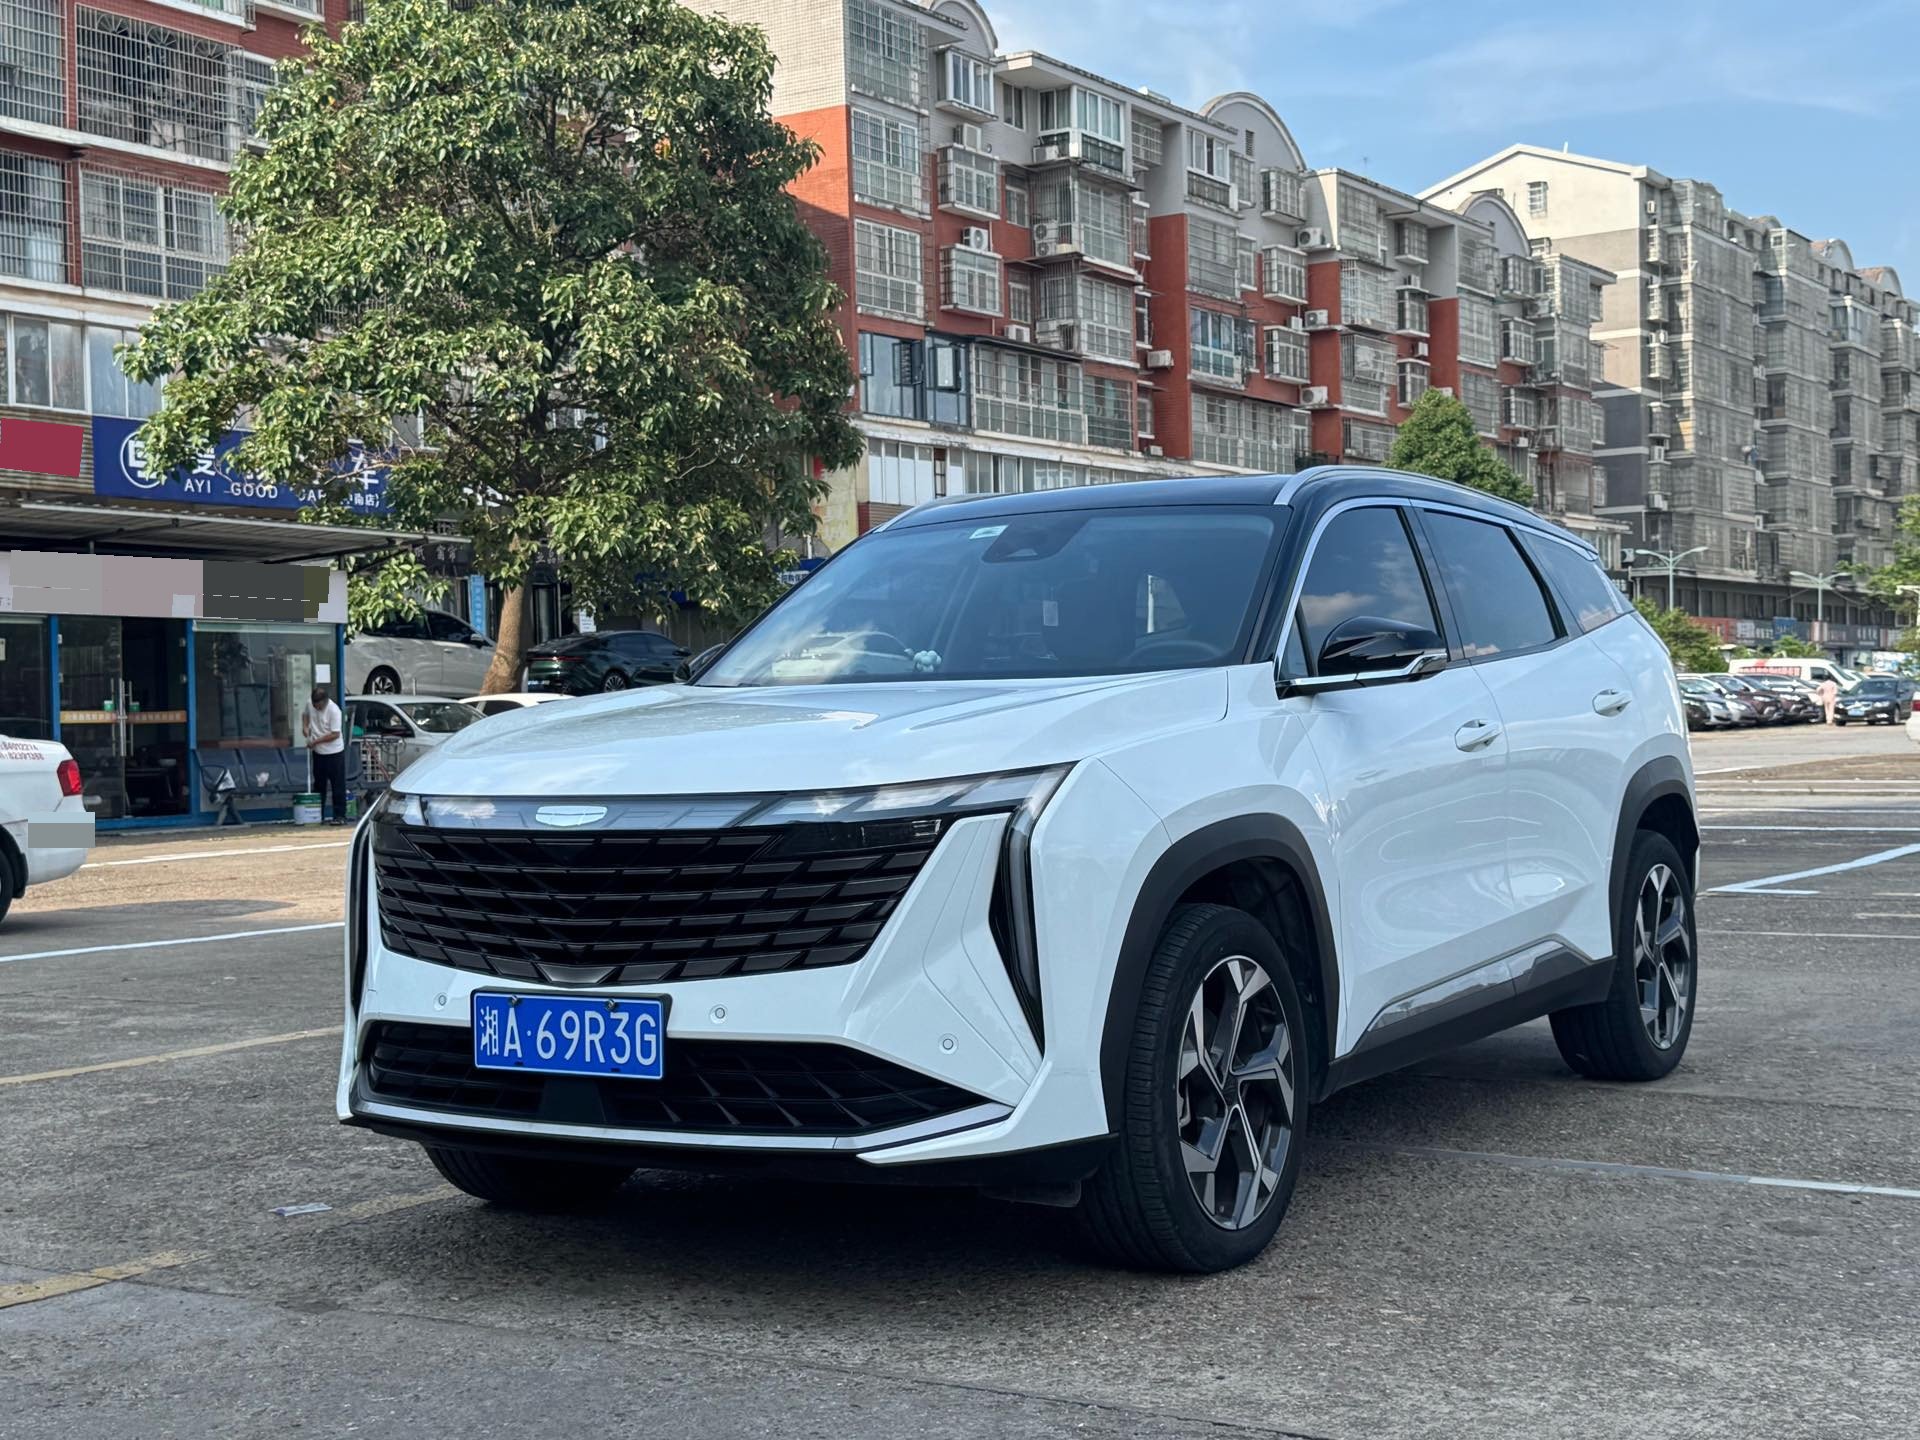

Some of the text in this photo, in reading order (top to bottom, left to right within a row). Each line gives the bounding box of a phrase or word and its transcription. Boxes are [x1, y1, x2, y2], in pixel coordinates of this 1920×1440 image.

[184, 478, 212, 494] AYI
[230, 482, 279, 499] GOOD
[480, 1005, 657, 1066] 湘A·69R3G
